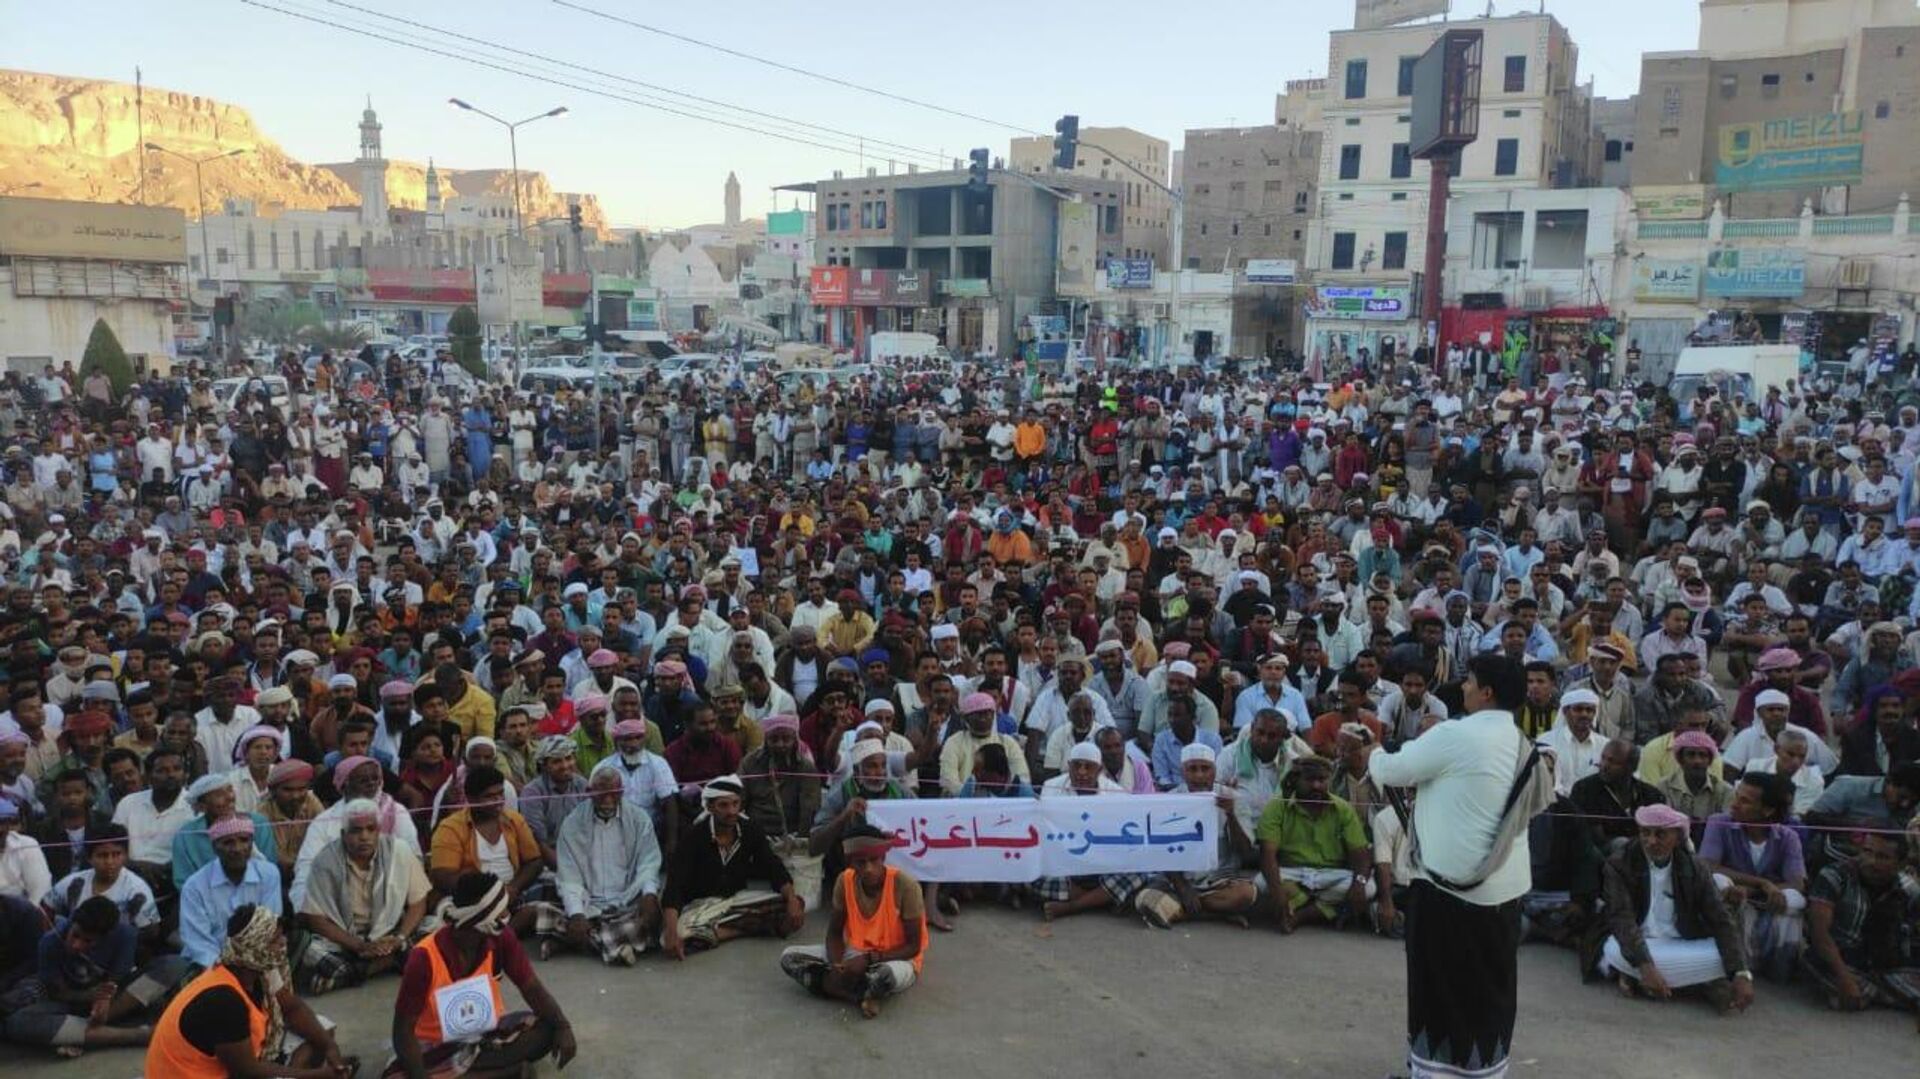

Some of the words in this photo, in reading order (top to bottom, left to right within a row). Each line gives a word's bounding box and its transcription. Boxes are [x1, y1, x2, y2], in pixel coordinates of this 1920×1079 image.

[1286, 79, 1327, 90] HOTEL
[1763, 110, 1863, 141] MEIZU
[1737, 268, 1804, 283] MEIZU
